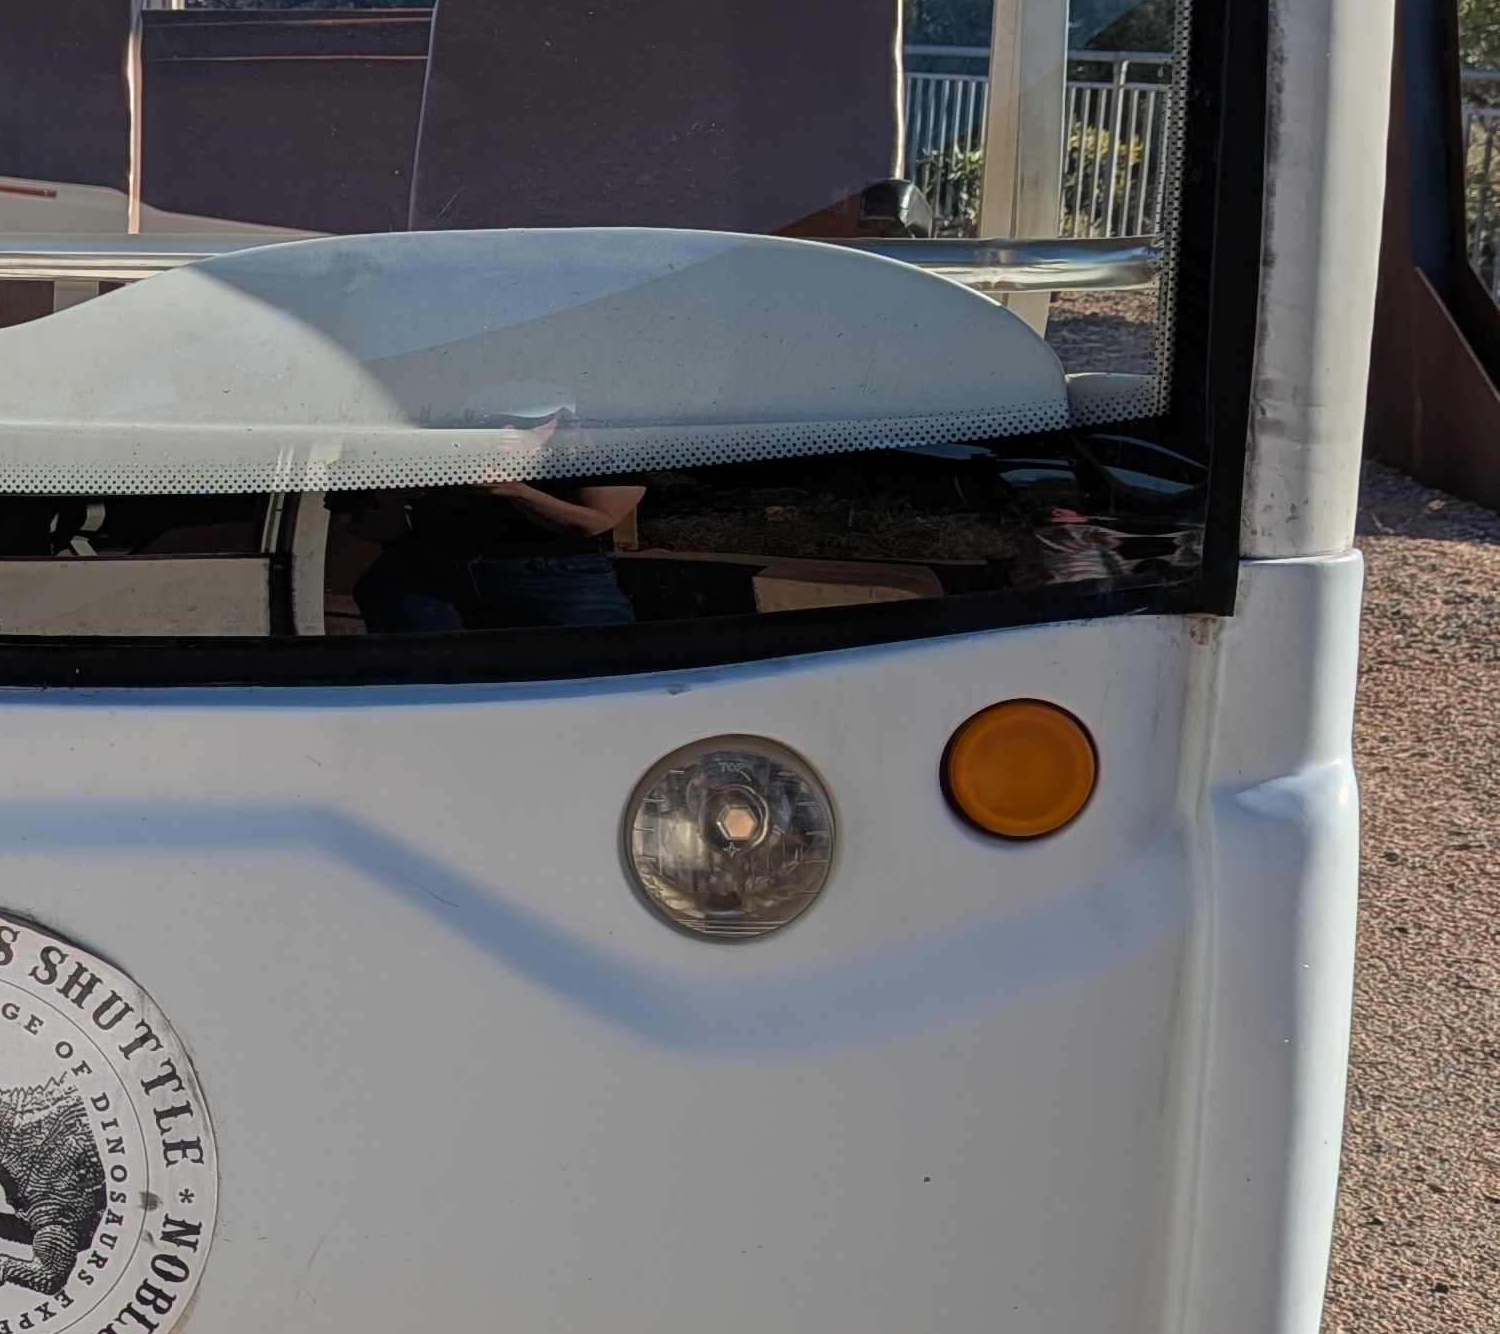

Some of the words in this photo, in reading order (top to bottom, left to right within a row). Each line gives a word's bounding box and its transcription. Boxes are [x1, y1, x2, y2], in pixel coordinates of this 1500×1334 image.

[27, 945, 205, 1169] SHUTTLE
[55, 1040, 93, 1081] OF
[77, 1093, 129, 1287] DINOSAURS
